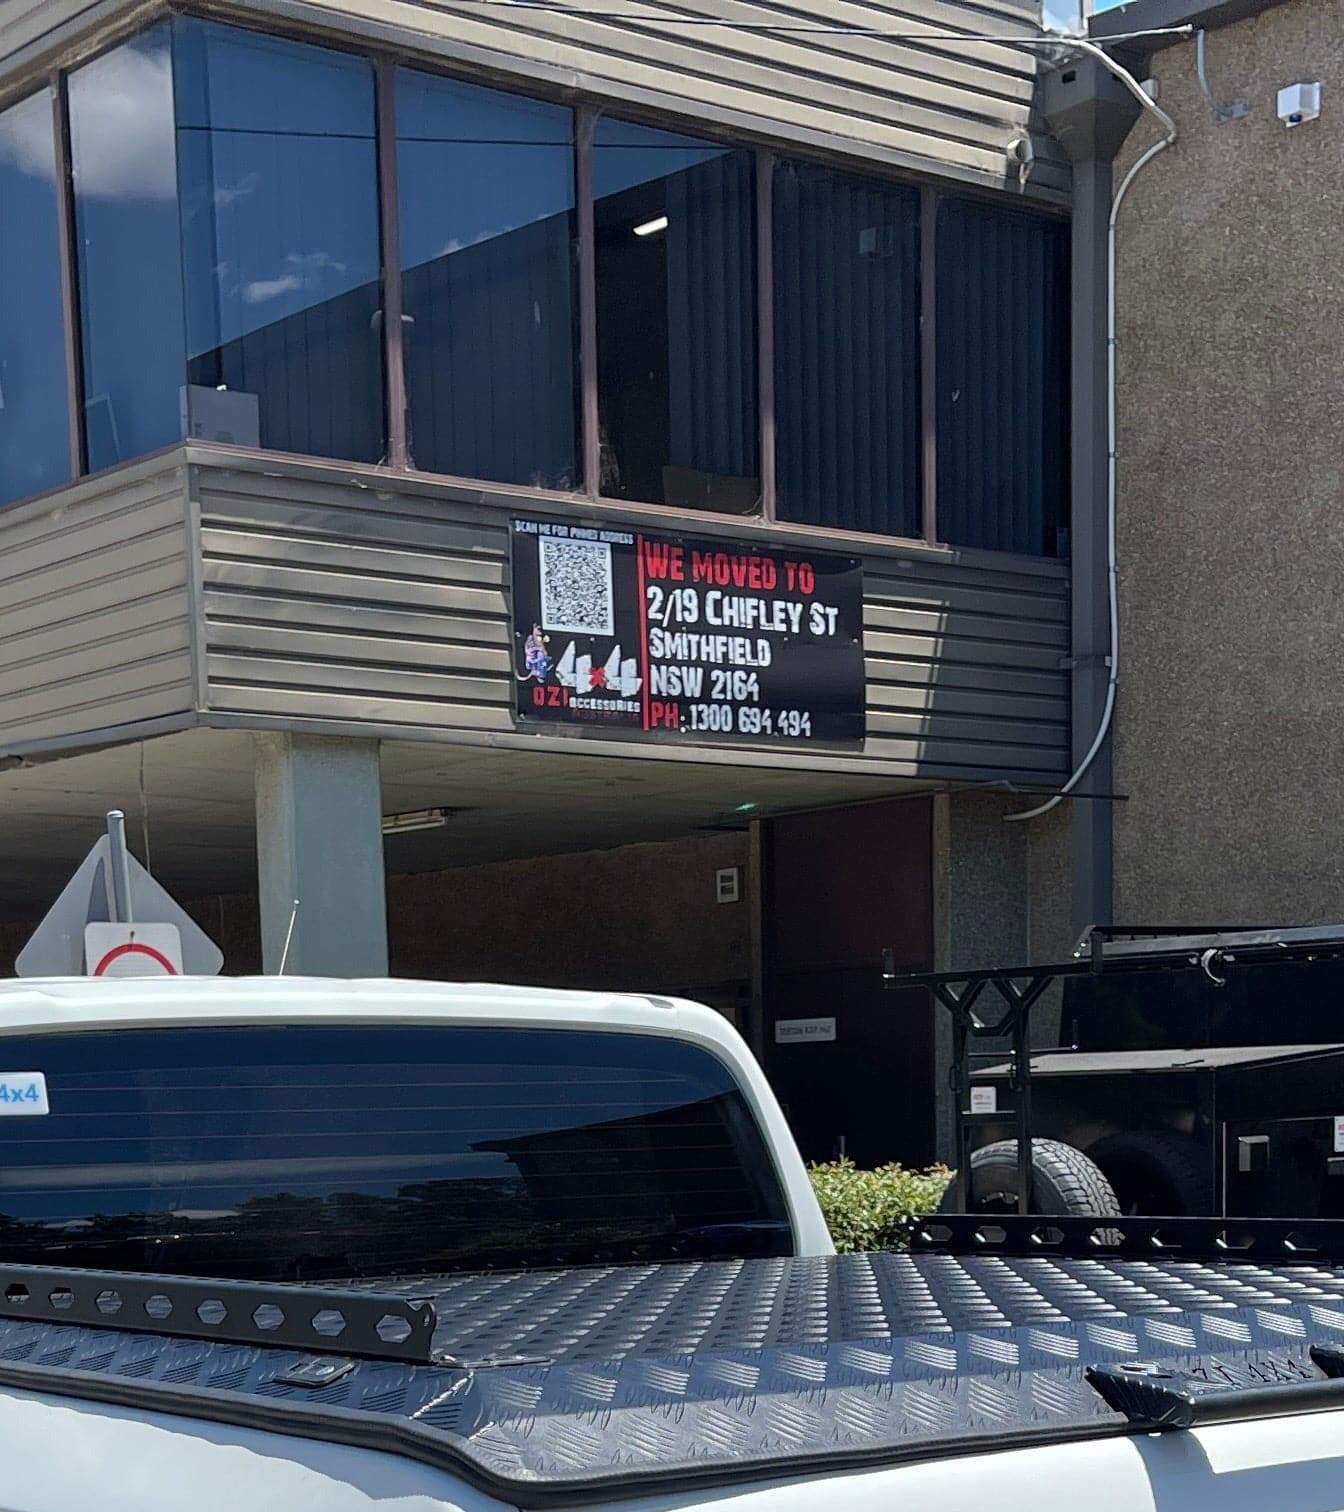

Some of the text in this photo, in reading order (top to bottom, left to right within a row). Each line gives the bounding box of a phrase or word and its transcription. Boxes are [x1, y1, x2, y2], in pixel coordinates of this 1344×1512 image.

[644, 541, 815, 595] WE MOVED TO
[647, 585, 839, 637] 2/19 CHIFLEY ST
[648, 627, 772, 668] SMITHFIELD
[533, 685, 569, 707] OZI
[650, 664, 760, 702] NSW 2164
[569, 697, 641, 713] ACCESSORIES
[689, 703, 733, 733] 1300
[738, 706, 772, 735] 694
[777, 709, 811, 737] 494
